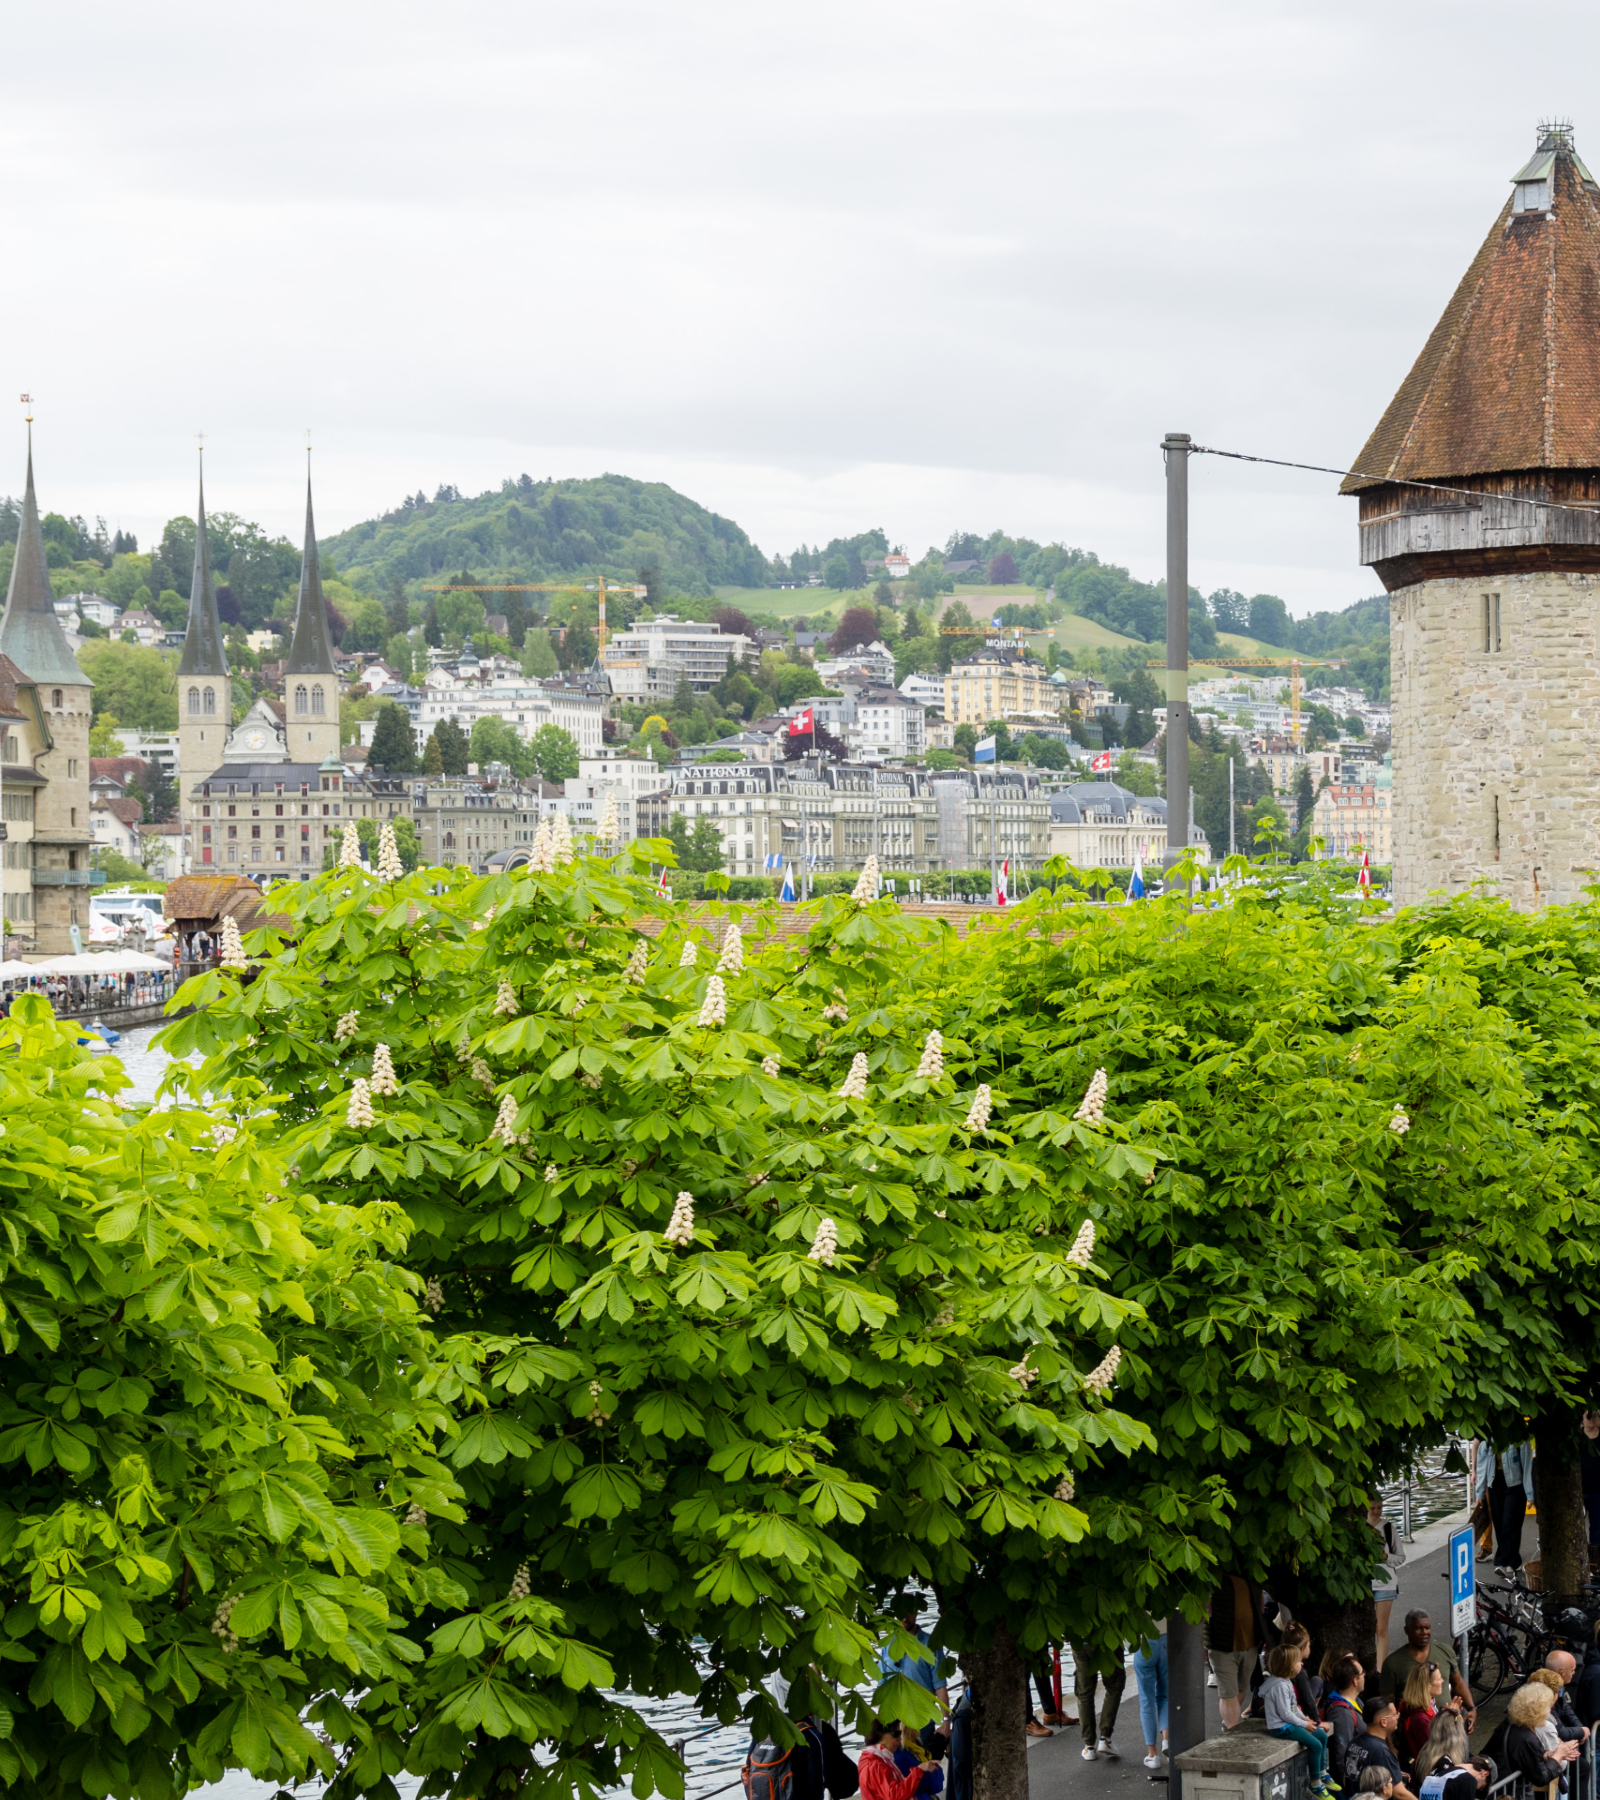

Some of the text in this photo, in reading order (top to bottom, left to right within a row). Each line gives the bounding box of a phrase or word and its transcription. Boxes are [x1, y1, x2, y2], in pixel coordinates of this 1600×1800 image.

[985, 639, 1031, 648] MONTANA
[682, 767, 755, 778] NATIONAL
[796, 769, 818, 780] HOTEL
[876, 772, 905, 783] NATIONAL
[1457, 1541, 1469, 1594] P
